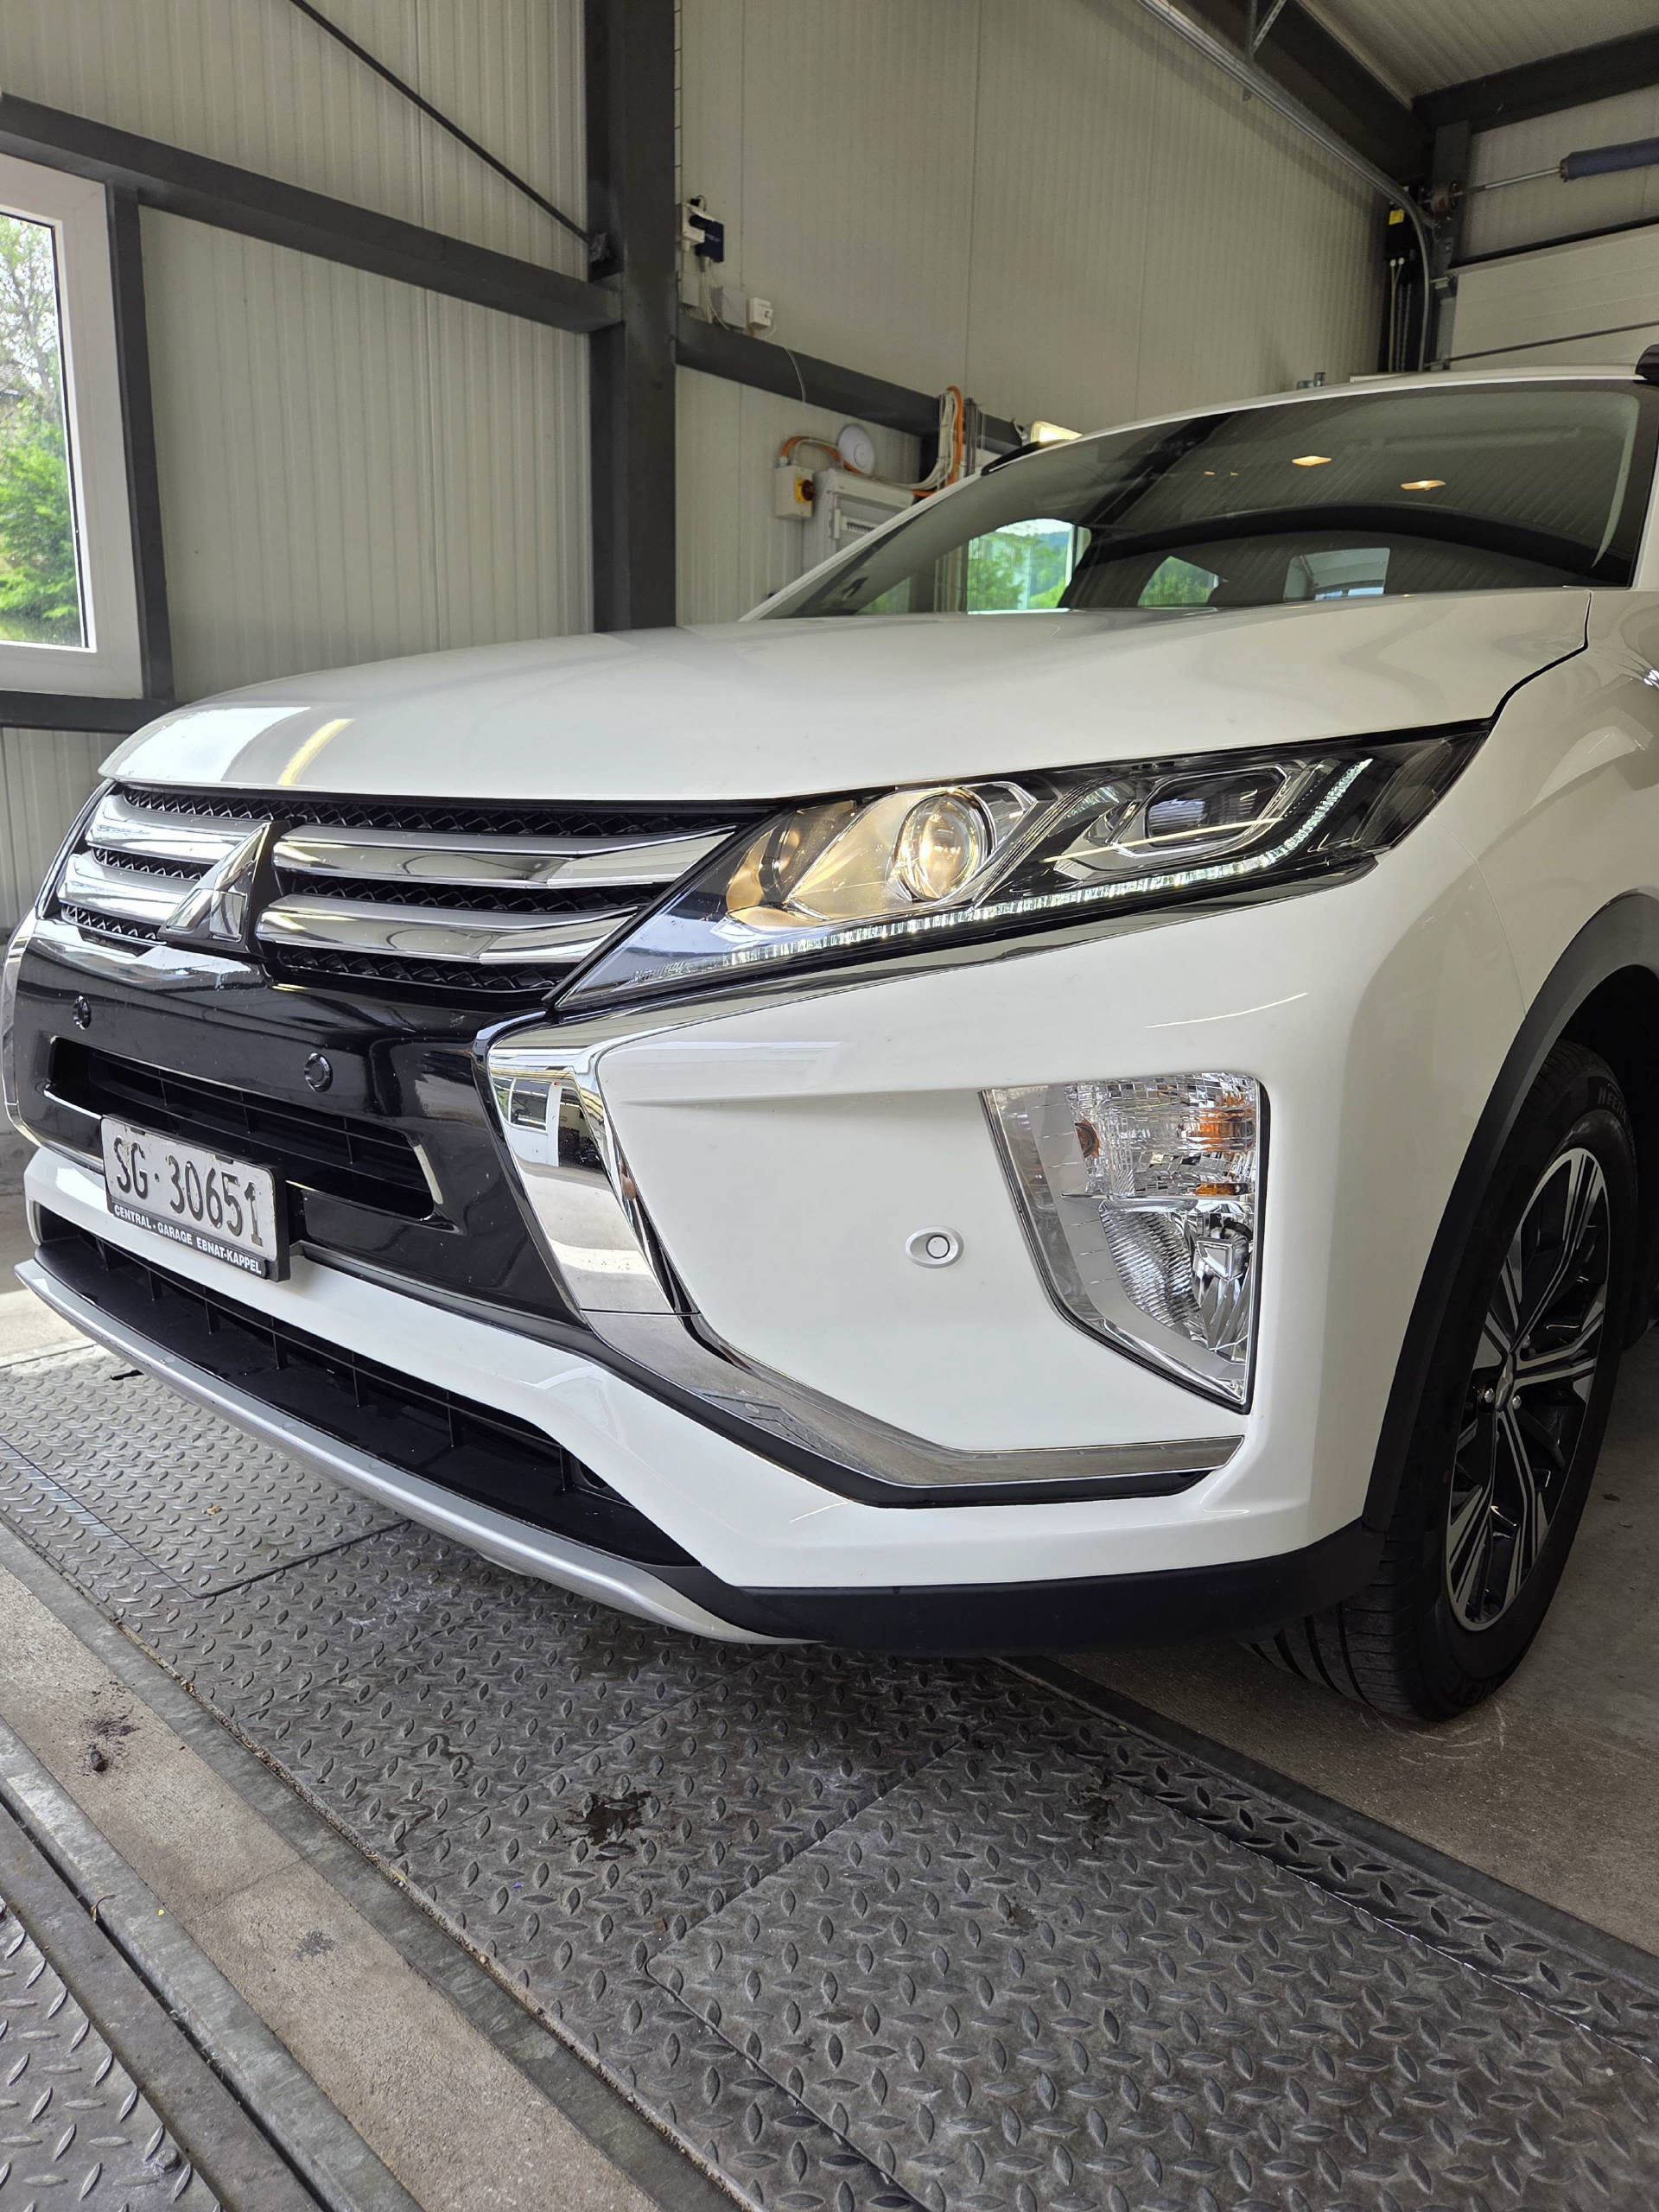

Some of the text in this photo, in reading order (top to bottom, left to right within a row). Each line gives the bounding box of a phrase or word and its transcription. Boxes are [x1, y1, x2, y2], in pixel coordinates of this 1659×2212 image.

[113, 1135, 149, 1200] SG
[165, 1154, 263, 1247] 30651
[114, 1204, 152, 1229] CENTRAL
[157, 1222, 193, 1245] GARAGE
